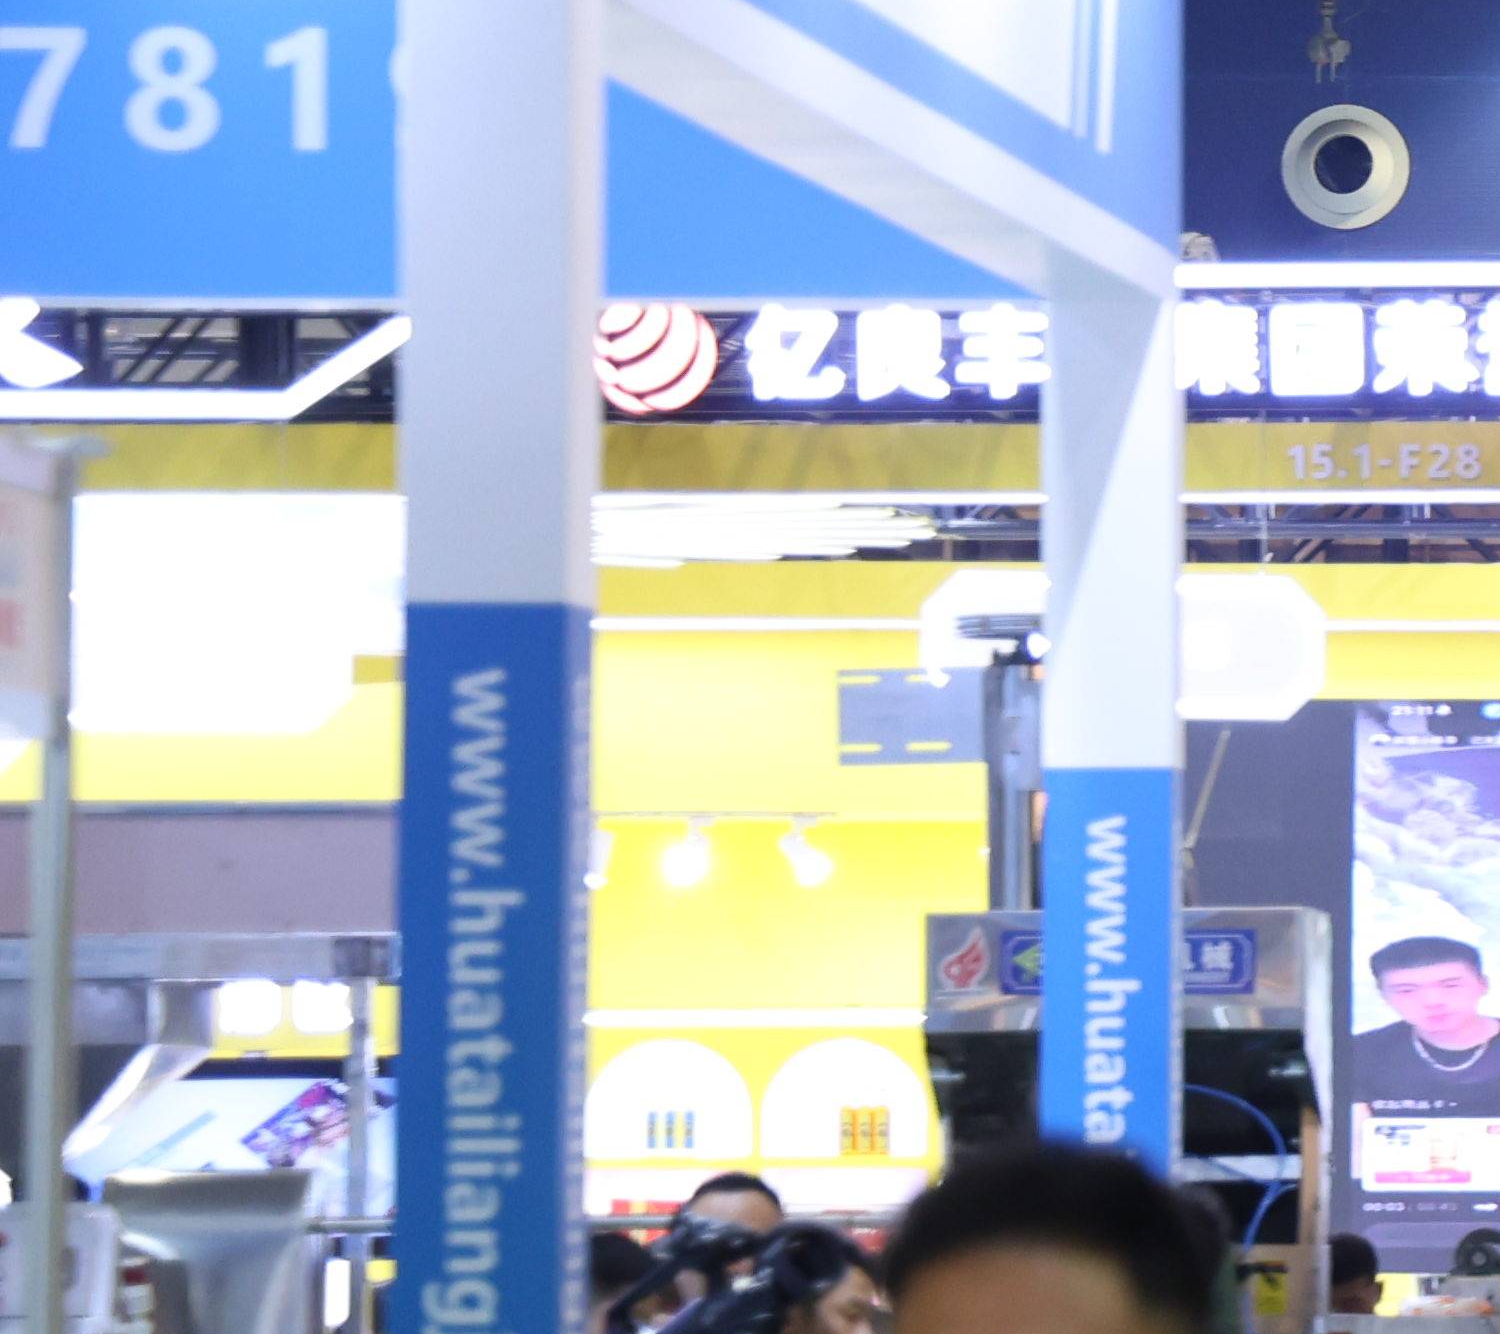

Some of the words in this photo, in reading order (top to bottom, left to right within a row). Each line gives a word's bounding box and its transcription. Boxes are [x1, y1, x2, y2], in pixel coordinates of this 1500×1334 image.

[0, 25, 402, 153] 781
[1286, 443, 1482, 481] 15.1-F28
[1082, 813, 1141, 1147] www.huata
